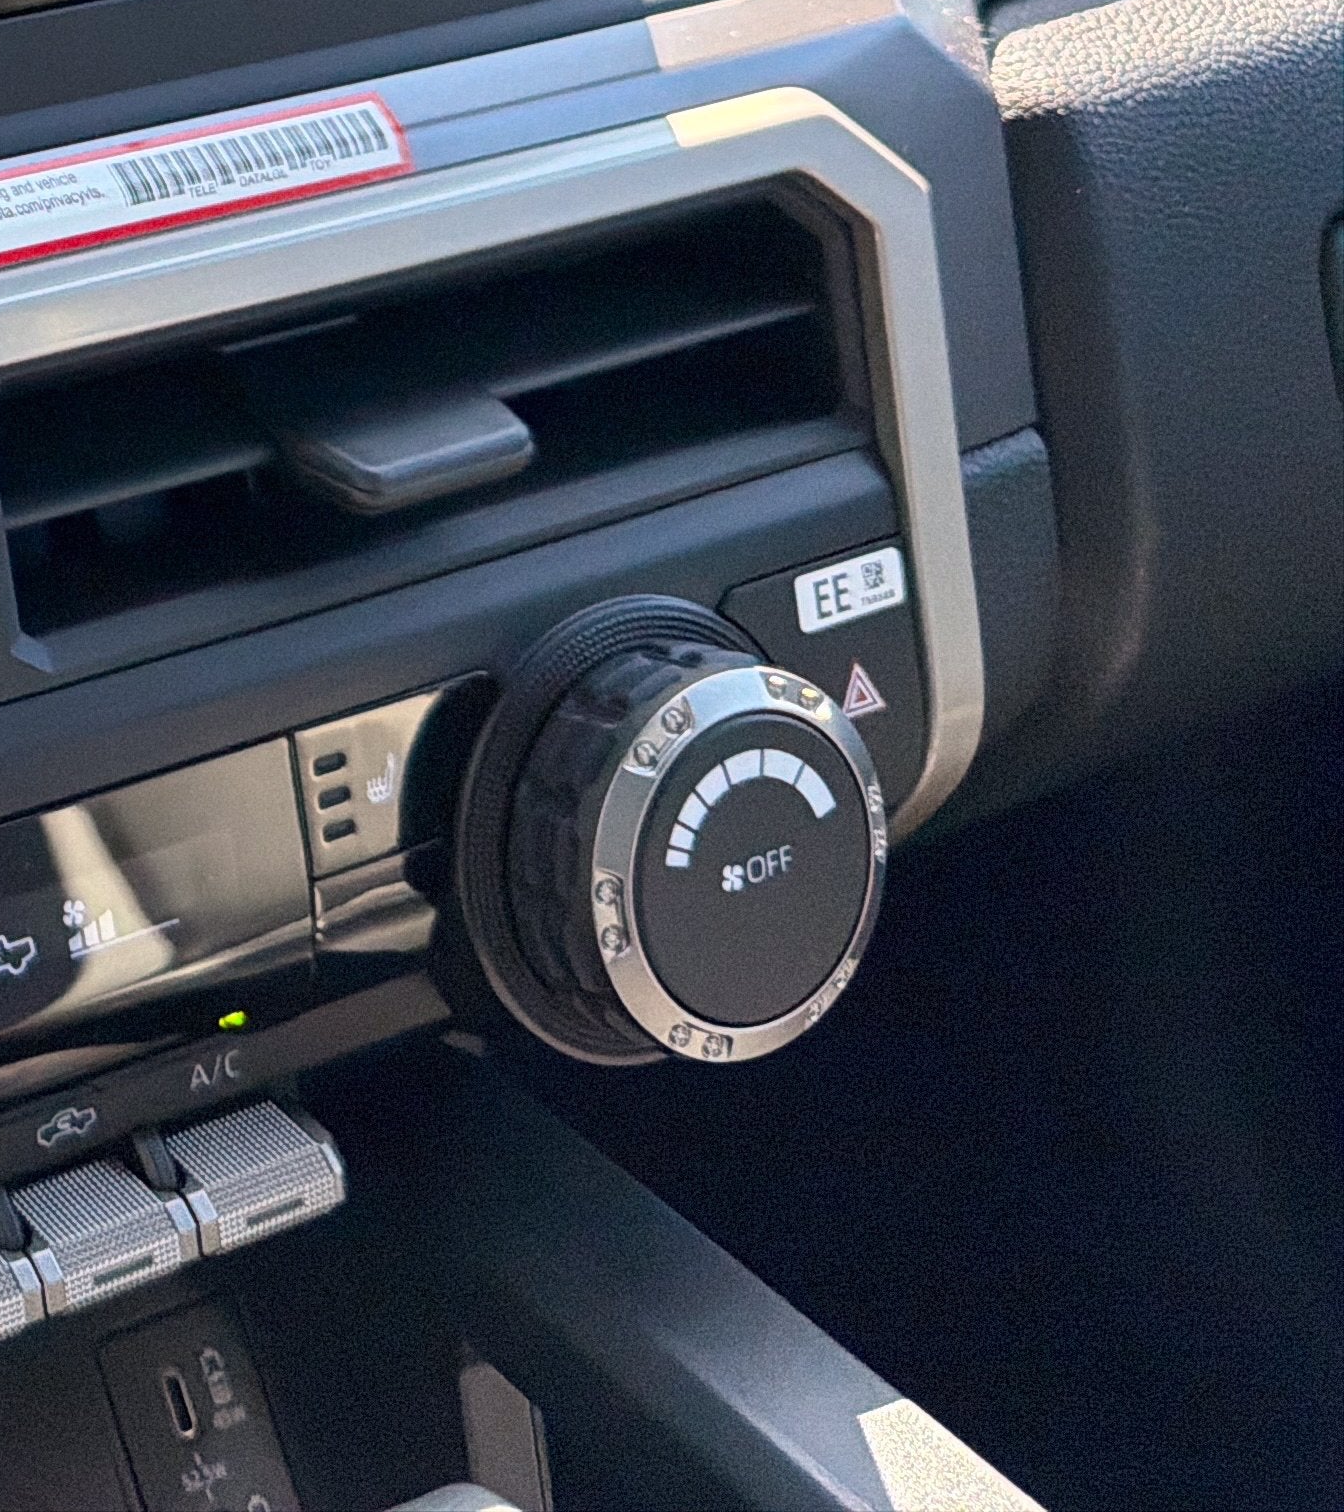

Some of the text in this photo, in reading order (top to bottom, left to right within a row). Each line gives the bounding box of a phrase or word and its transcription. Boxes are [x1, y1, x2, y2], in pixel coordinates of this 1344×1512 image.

[11, 182, 34, 197] and
[36, 171, 78, 190] vehicle
[812, 572, 852, 620] EE
[745, 844, 793, 886] OFF
[189, 1048, 242, 1090] A/C
